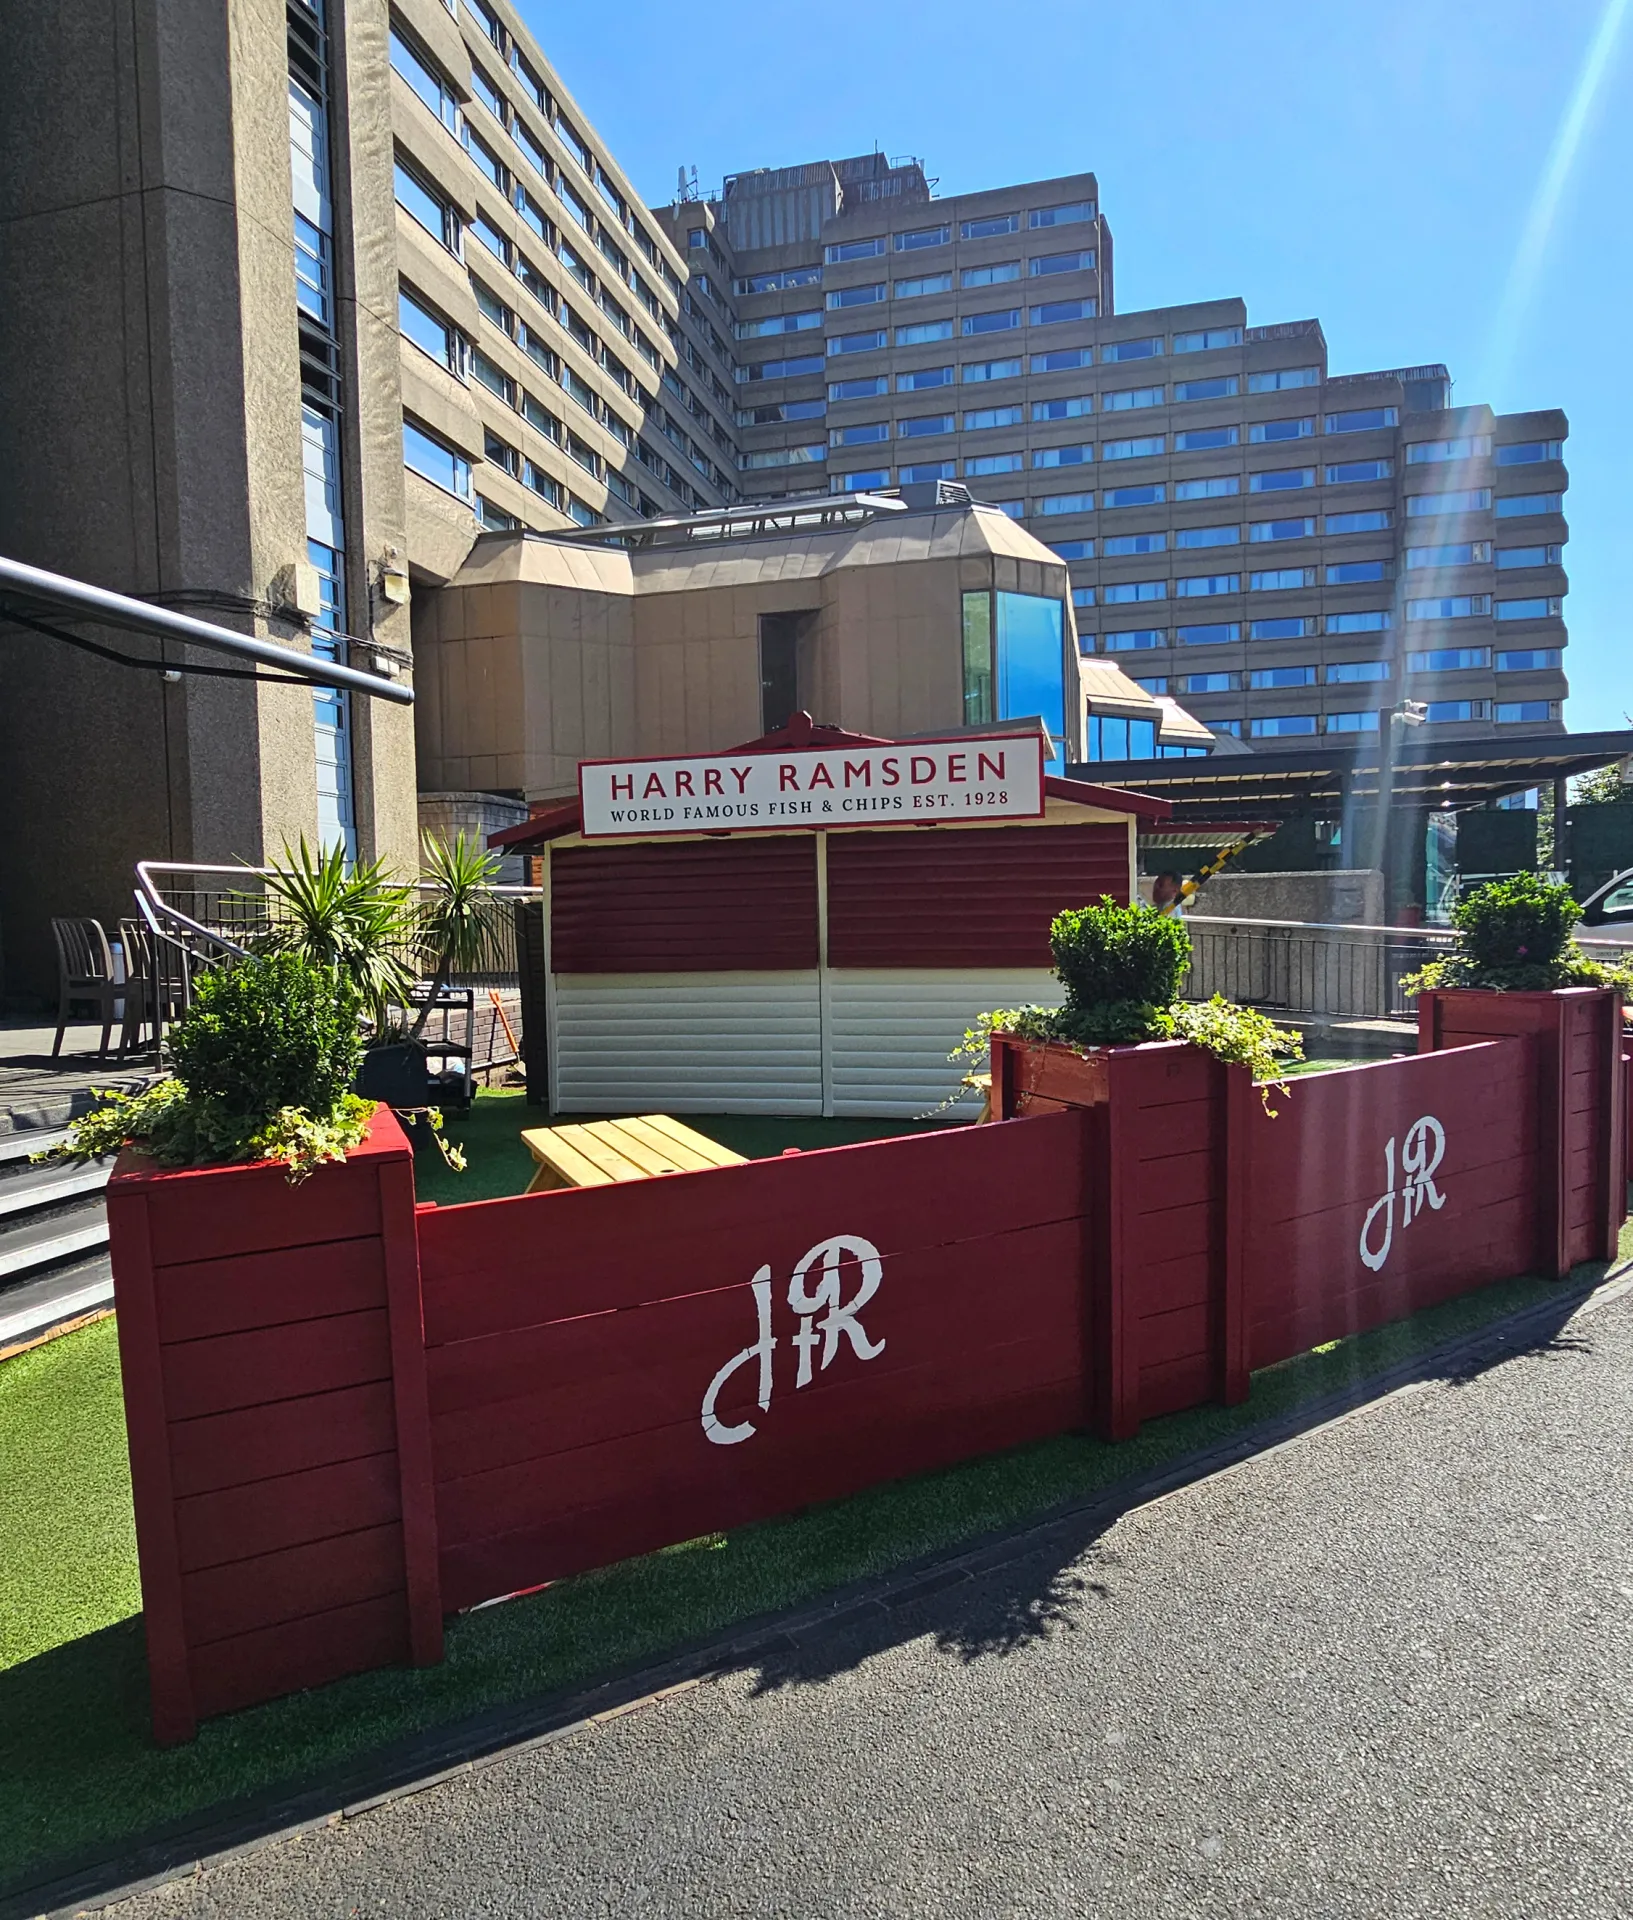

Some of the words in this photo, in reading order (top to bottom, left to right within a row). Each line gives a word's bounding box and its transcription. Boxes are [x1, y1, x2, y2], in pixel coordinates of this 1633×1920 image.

[611, 766, 752, 800] HARRY
[779, 752, 1005, 791] RAMSDEN
[610, 808, 674, 822] WORLD
[683, 804, 759, 819] FAMOUS
[769, 801, 812, 815] FISH
[822, 800, 833, 812] &
[842, 797, 903, 811] CHIPS
[913, 794, 955, 808] EST.
[965, 791, 1009, 806] 1928
